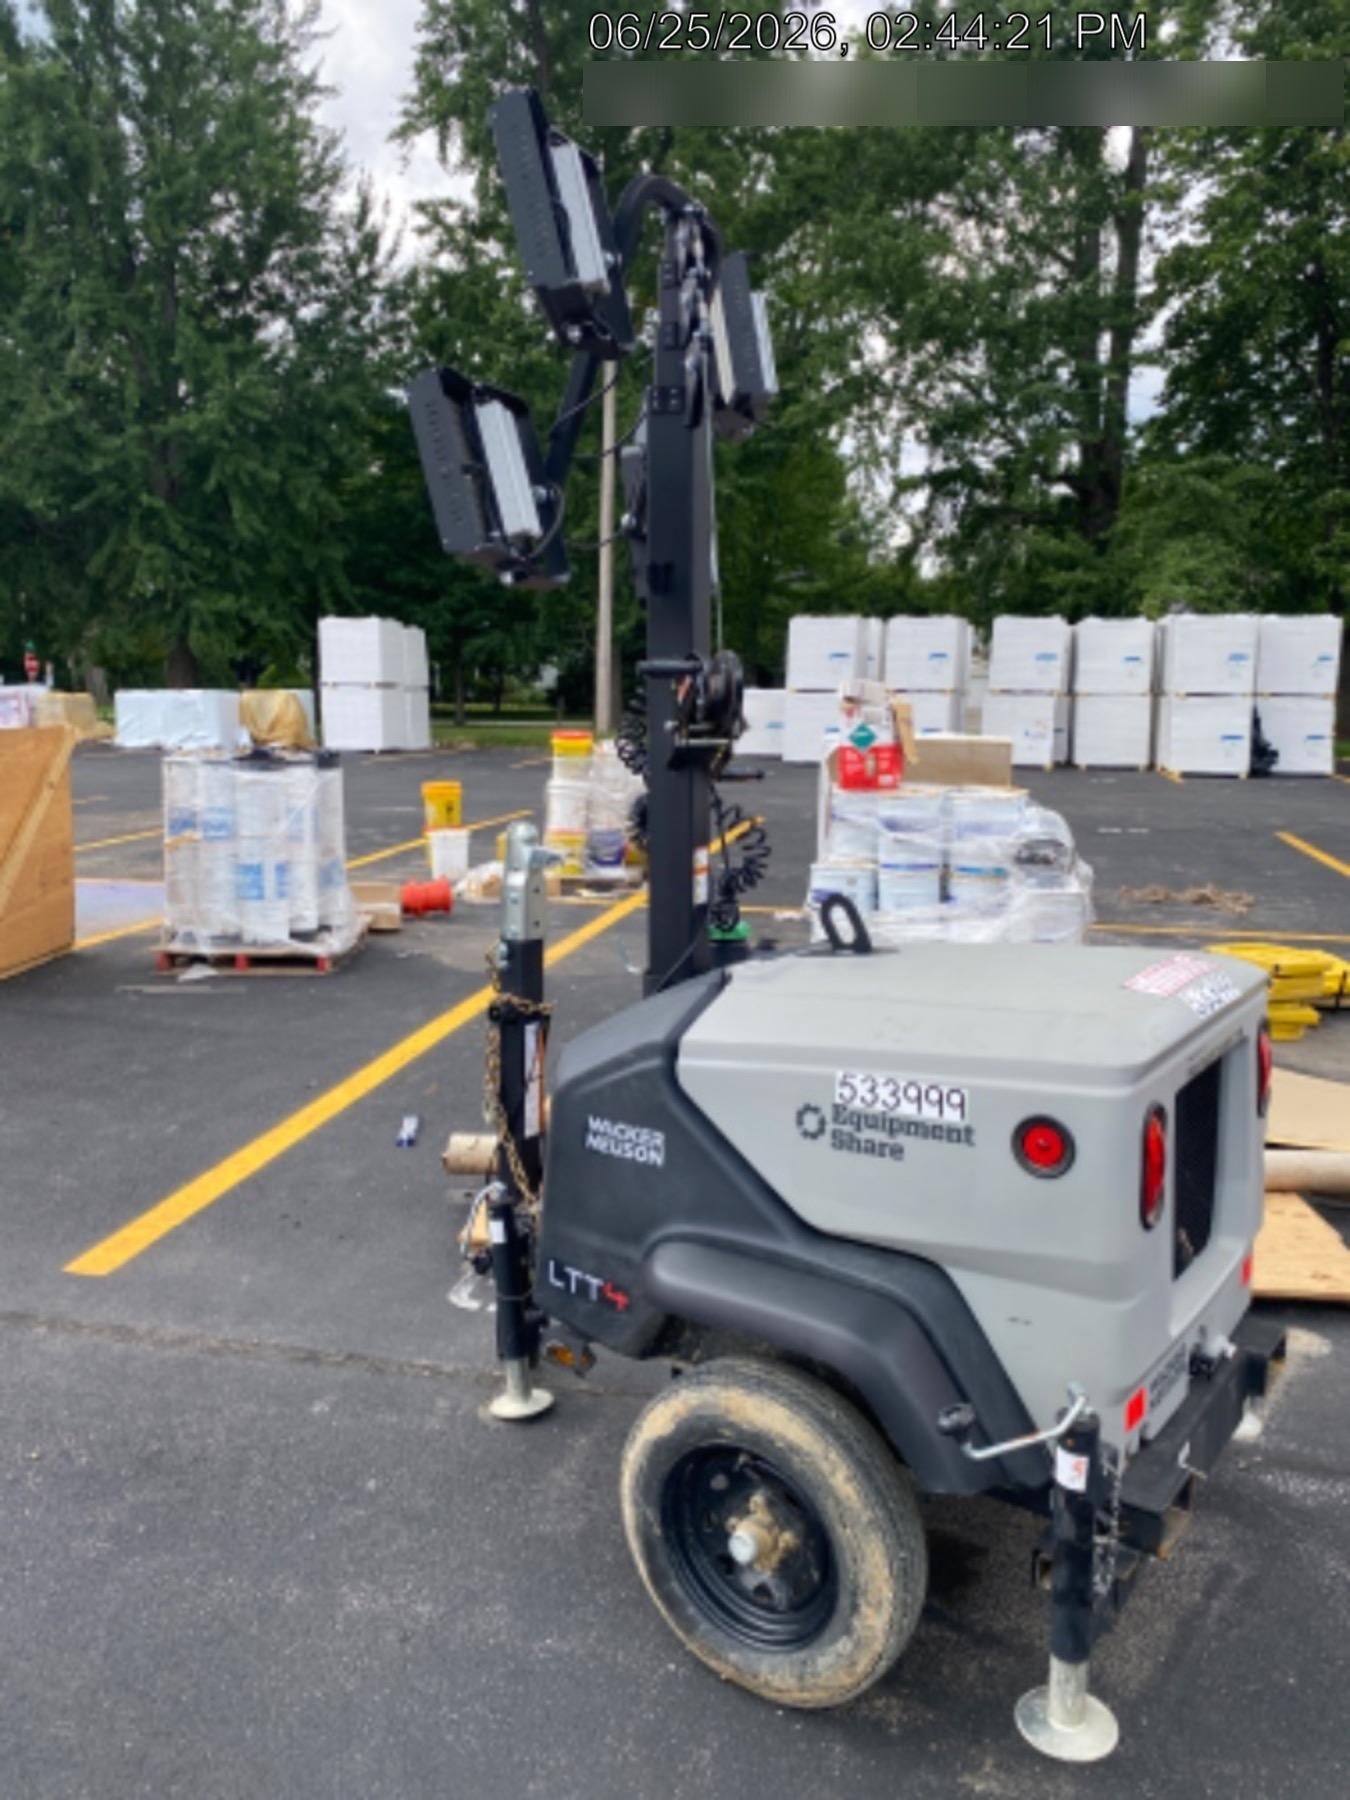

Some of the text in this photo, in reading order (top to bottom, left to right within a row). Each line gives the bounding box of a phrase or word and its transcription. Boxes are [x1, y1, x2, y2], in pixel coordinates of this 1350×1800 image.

[836, 1072, 967, 1121] 533999
[830, 1129, 905, 1161] Share
[831, 1103, 976, 1147] Equipment
[585, 1134, 665, 1168] NEUSON
[548, 1260, 629, 1311] LTT4
